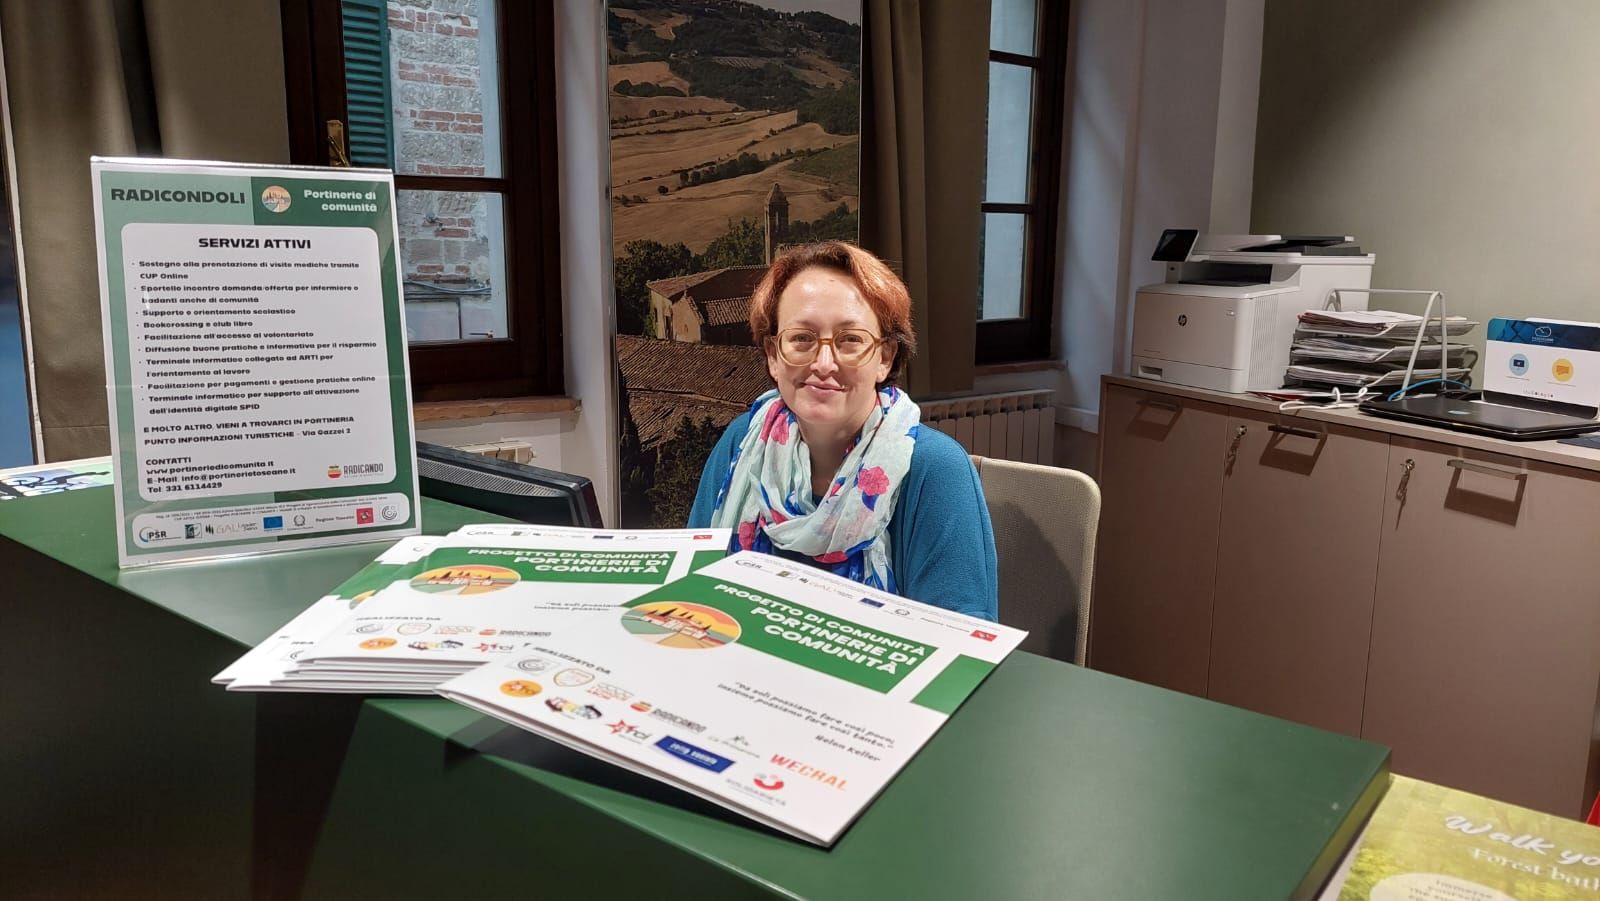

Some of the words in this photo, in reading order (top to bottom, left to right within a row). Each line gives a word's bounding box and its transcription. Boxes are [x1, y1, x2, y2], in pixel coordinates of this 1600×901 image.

[111, 188, 246, 204] RADICONDOLI
[303, 189, 362, 200] Portinerie
[364, 191, 376, 200] di
[321, 201, 378, 212] comunità
[198, 237, 260, 248] SERVIZI
[264, 239, 312, 249] ATTIVI
[139, 261, 182, 269] Sostegno
[202, 261, 258, 269] prenotazione
[141, 285, 181, 293] Sportello
[142, 309, 185, 317] Supporto
[143, 321, 204, 329] Bookcrossing
[144, 333, 202, 341] Facilitazione
[222, 344, 258, 352] pratiche
[339, 341, 377, 349] risparmio
[245, 355, 284, 363] collegato
[147, 382, 205, 390] Facilitazione
[207, 381, 222, 389] per
[223, 379, 270, 388] pagamenti
[279, 378, 315, 386] gestione
[316, 377, 350, 385] pratiche
[148, 394, 193, 402] Terminale
[195, 392, 246, 400] informatico
[247, 391, 262, 399] per
[263, 390, 301, 398] supporto
[204, 404, 239, 413] digitale
[239, 403, 260, 411] SPID
[151, 425, 182, 433] MOLTO
[216, 421, 240, 429] VIENI
[249, 418, 293, 427] TROVARCI
[304, 415, 355, 424] PORTINERIA
[144, 438, 177, 446] PUNTO
[178, 433, 243, 444] INFORMAZIONI
[244, 430, 295, 440] TURISTICHE
[302, 428, 316, 436] Via
[145, 456, 192, 466] CONTATTI
[343, 463, 384, 475] RADICANDO
[165, 484, 183, 492] 331
[184, 481, 223, 491] 6114429
[149, 529, 167, 539] PSR
[467, 548, 556, 558] PROGETTO
[578, 552, 671, 560] COMUNITÀ
[513, 556, 643, 567] PORTINERIE
[535, 564, 660, 573] COMUNITÀ
[714, 583, 802, 616] PROGETTO
[804, 612, 826, 624] DI
[826, 619, 925, 656] COMUNITÀ
[750, 605, 888, 656] PORTINERIE
[887, 651, 918, 666] DI
[763, 623, 898, 675] COMUNITÀ
[815, 734, 846, 750] Helen
[847, 746, 881, 762] Keller
[1445, 815, 1556, 856] Walk
[1471, 847, 1542, 876] Forest
